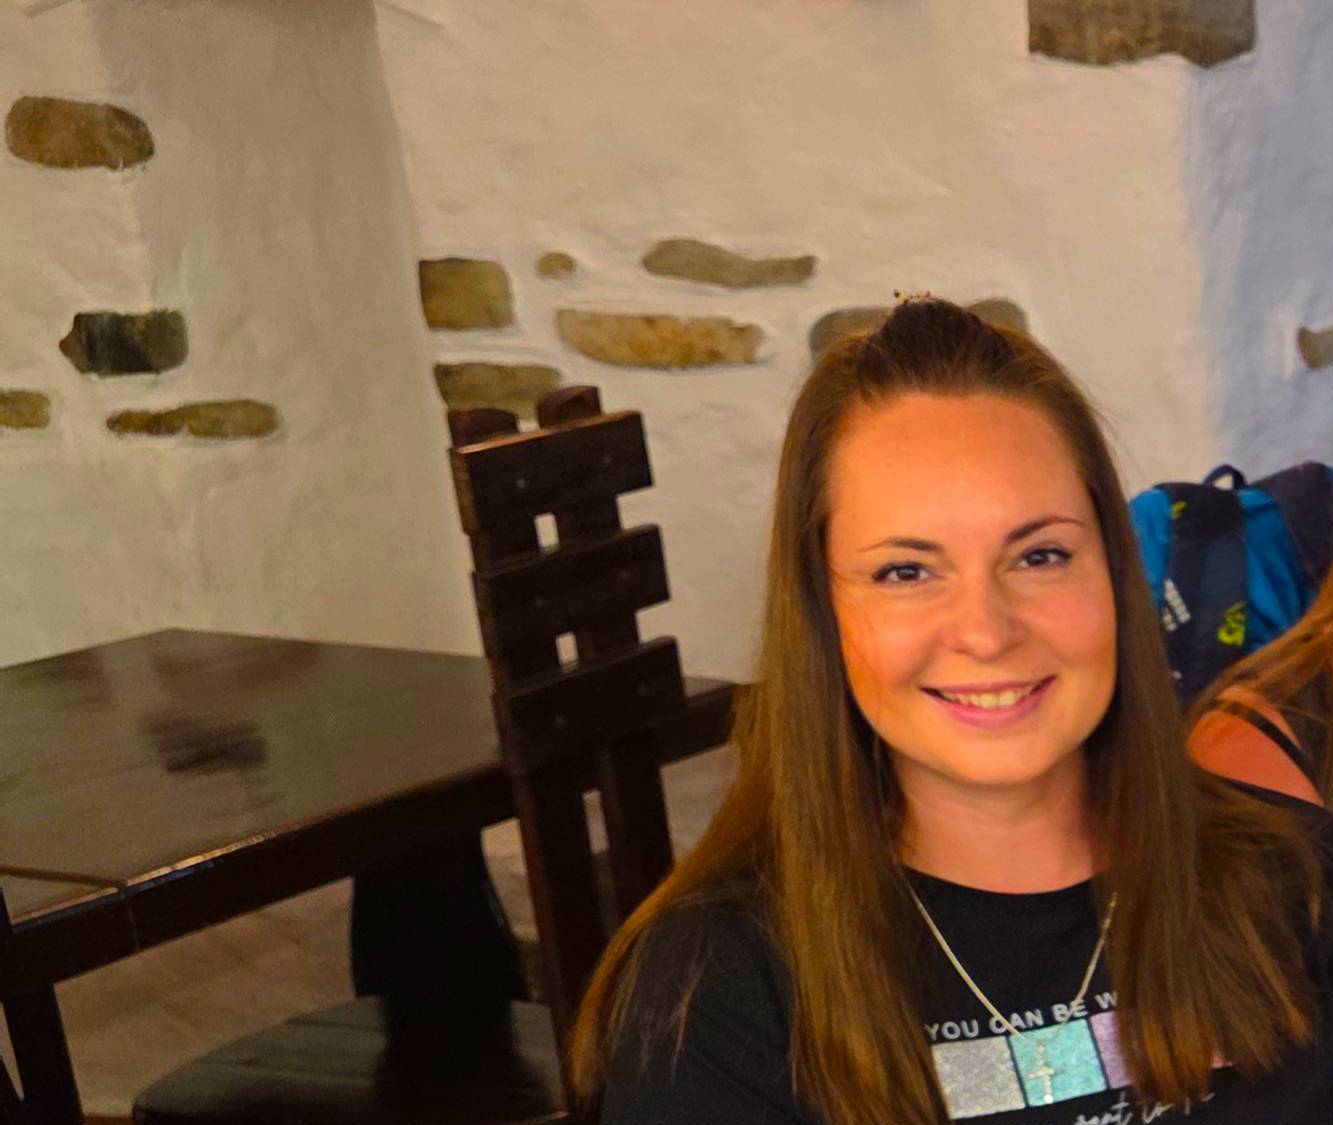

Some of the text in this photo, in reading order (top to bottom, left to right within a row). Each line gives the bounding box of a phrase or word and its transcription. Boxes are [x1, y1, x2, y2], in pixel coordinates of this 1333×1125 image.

[923, 1020, 979, 1041] YOU
[989, 1009, 1044, 1034] CAN
[1052, 998, 1088, 1023] BE
